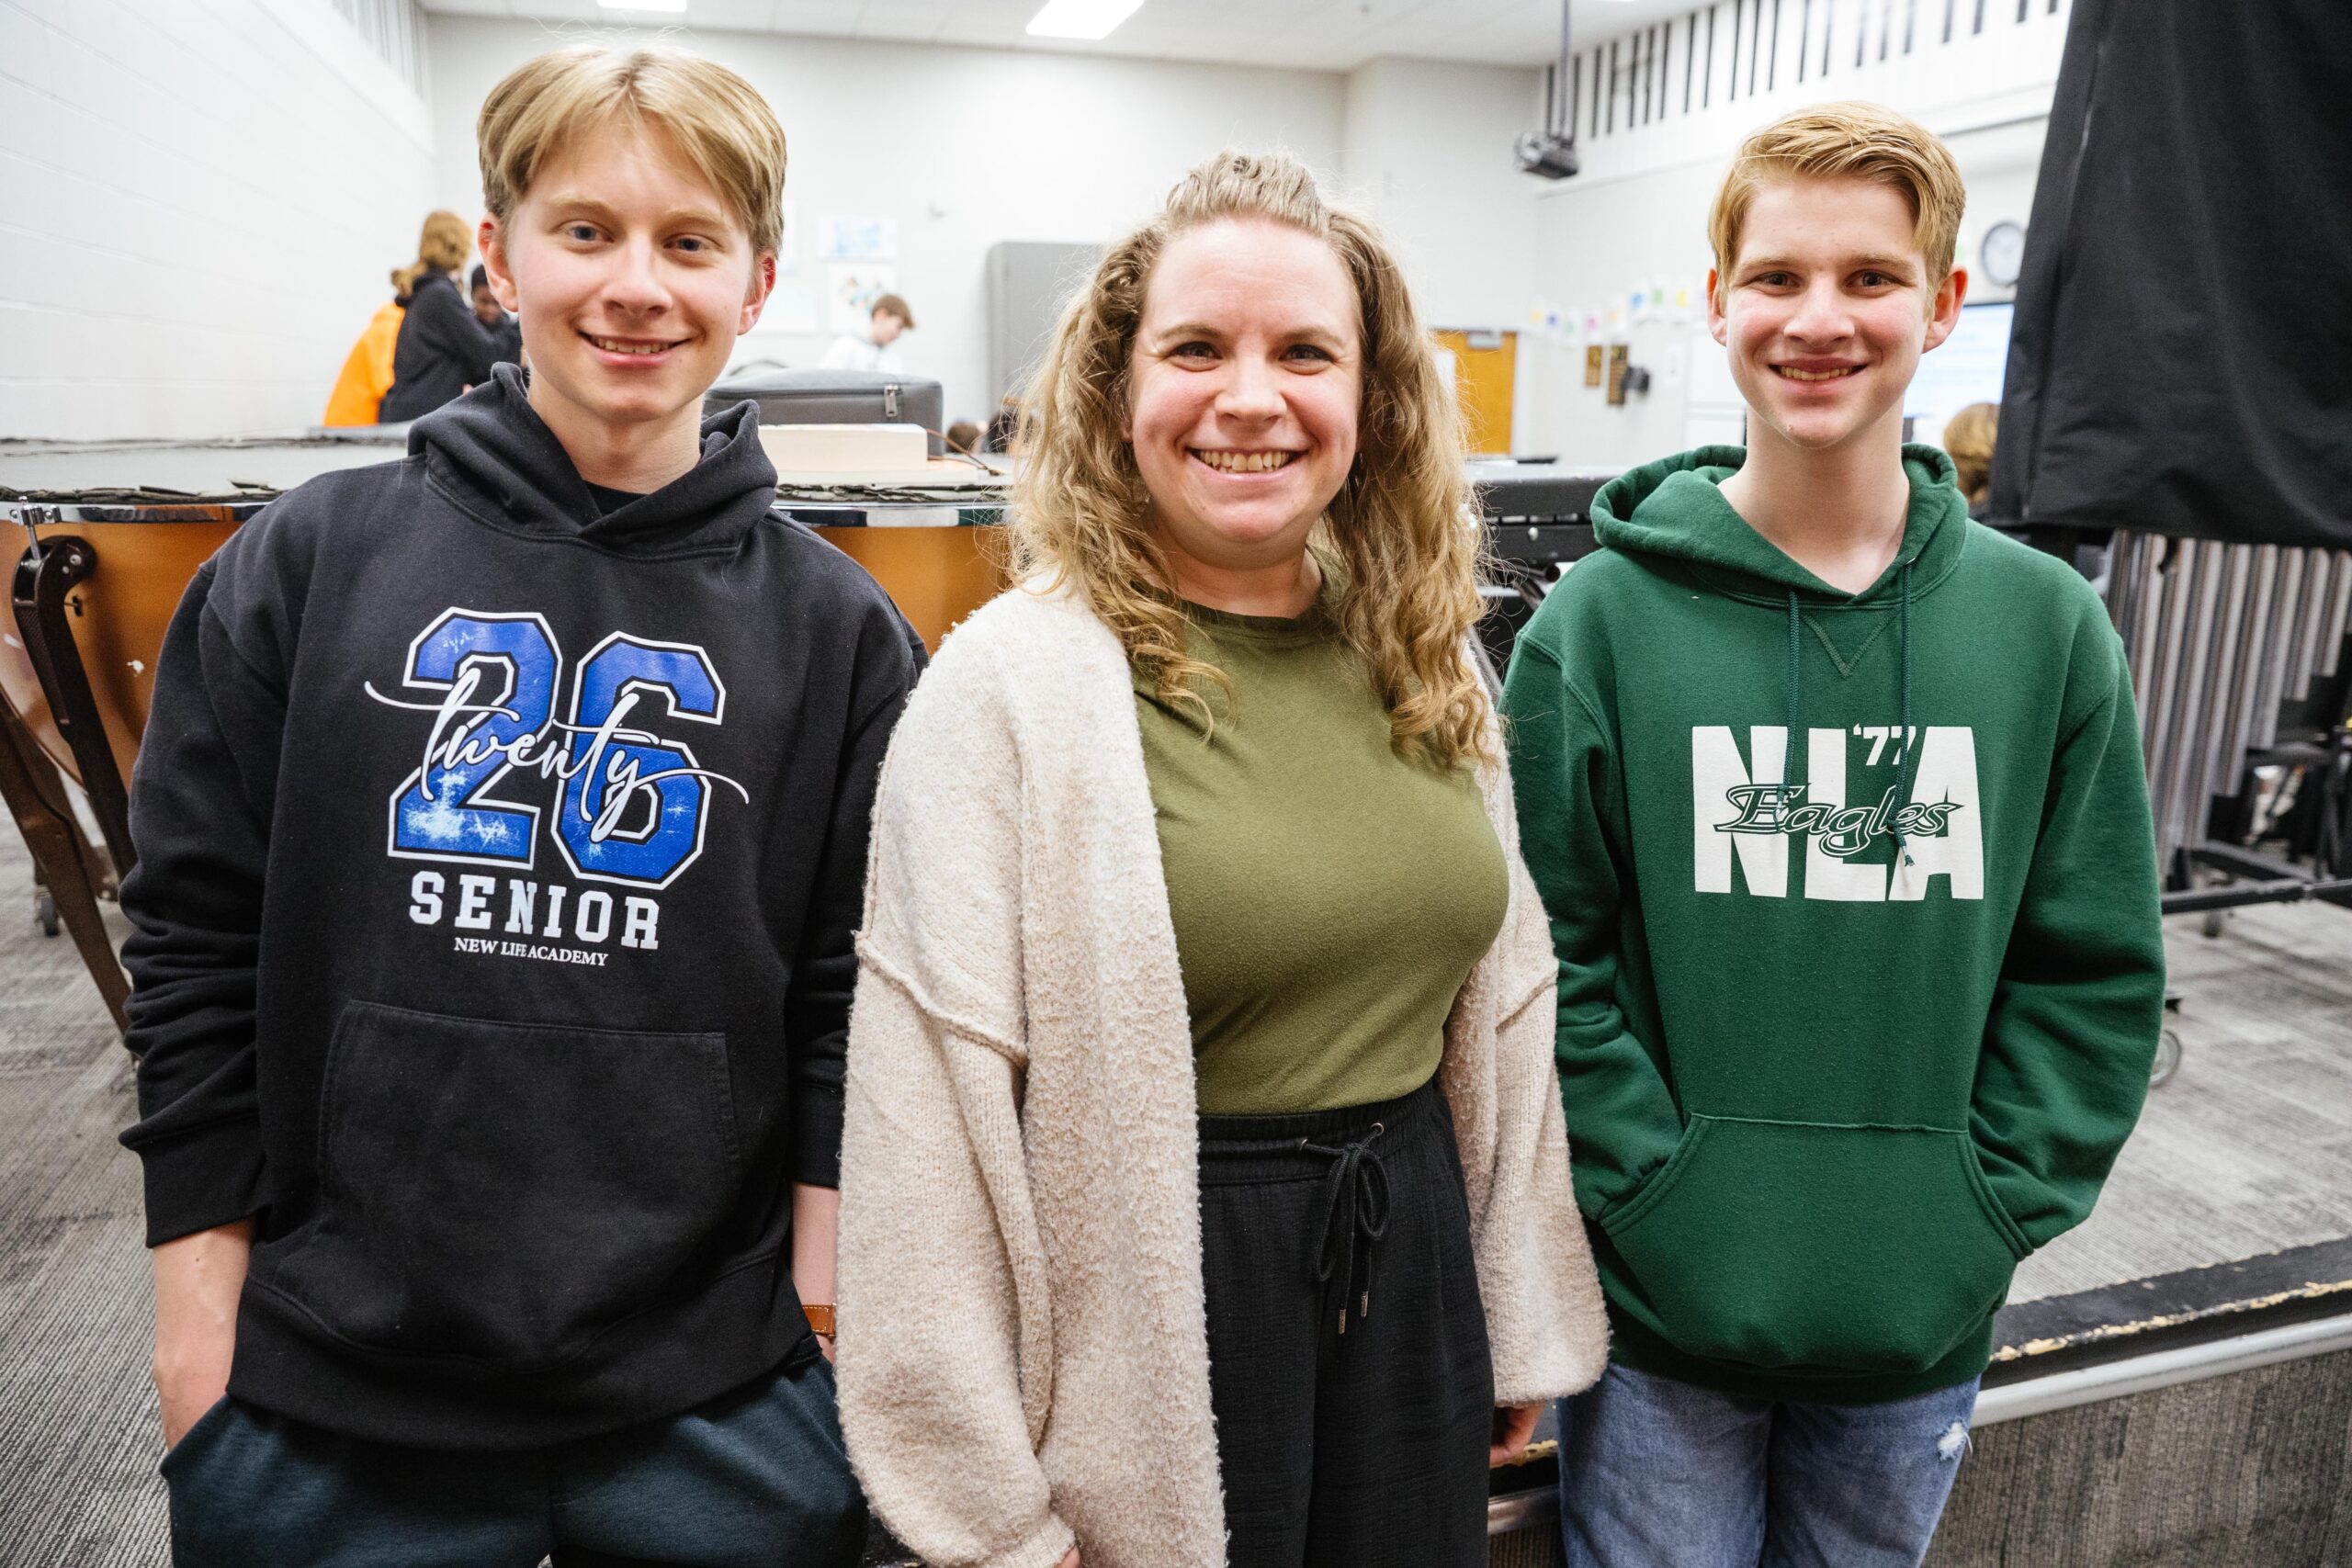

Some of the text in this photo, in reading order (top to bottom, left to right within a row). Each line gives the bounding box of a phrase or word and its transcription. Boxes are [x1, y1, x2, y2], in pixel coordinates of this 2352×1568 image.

[388, 606, 726, 890] 26
[1852, 723, 1917, 766] '77
[1691, 725, 1984, 902] NLA
[1713, 782, 1965, 857] Eagles
[409, 870, 661, 950] SENIOR
[453, 937, 609, 966] NEW LIFE ACADEMY
